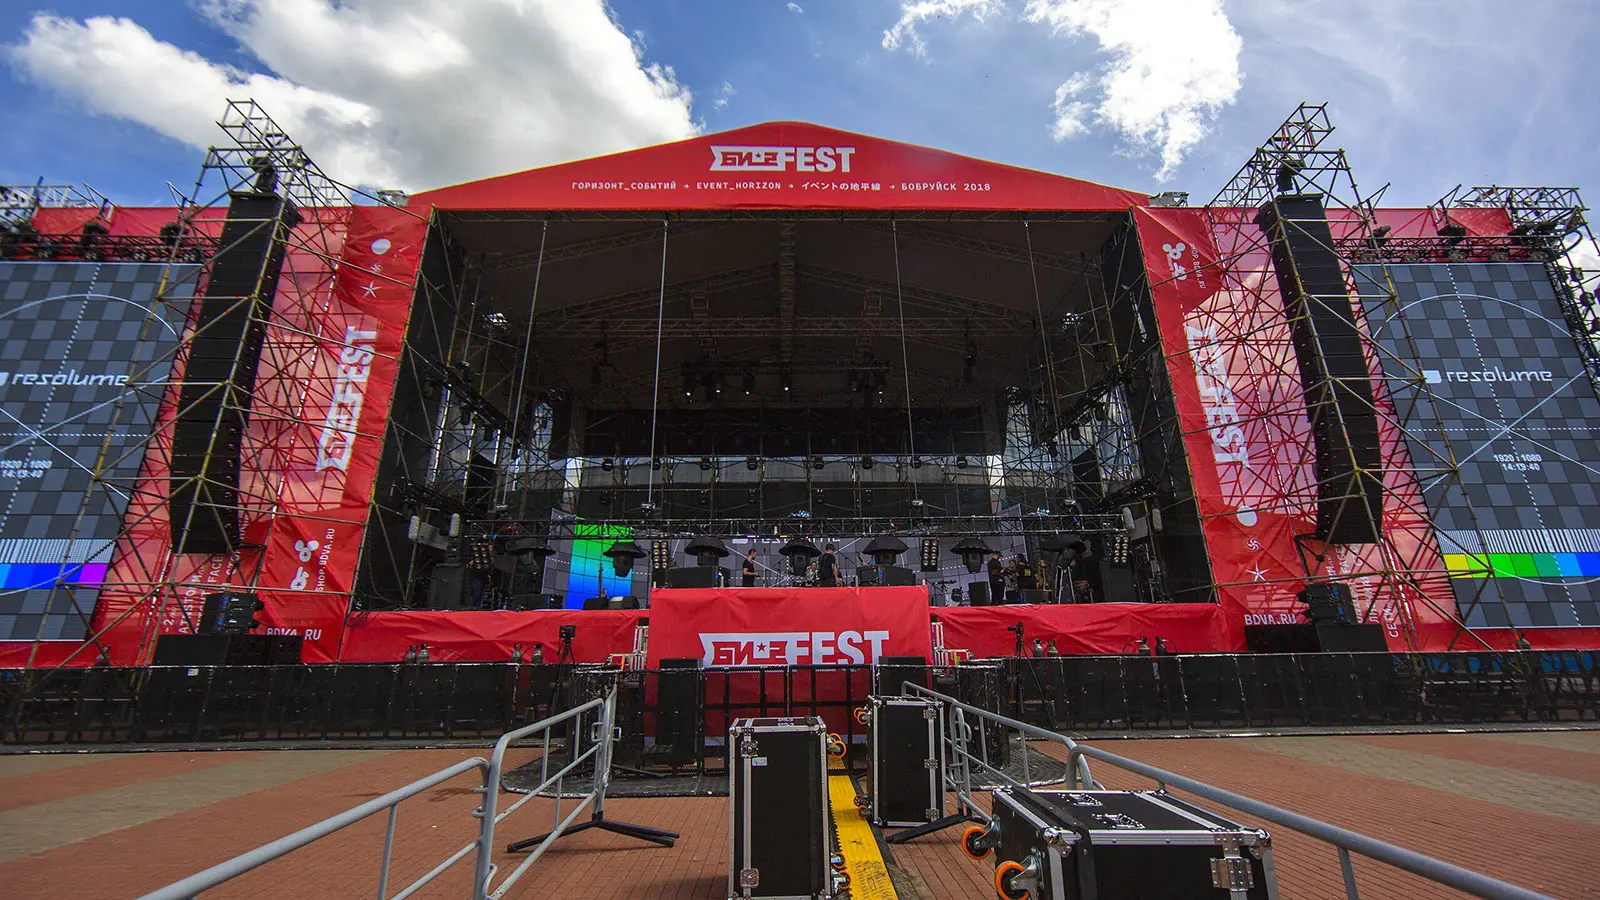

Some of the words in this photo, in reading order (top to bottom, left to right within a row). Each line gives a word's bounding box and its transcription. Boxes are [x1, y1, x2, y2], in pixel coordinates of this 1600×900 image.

[571, 181, 677, 190] ГОРИЗОНТ_СОБЫТИЙ
[696, 182, 782, 190] EVENT_HORIZON
[901, 181, 957, 191] БОБРУЙСК
[963, 183, 991, 191] 2018
[12, 369, 130, 386] resolume
[1445, 366, 1553, 382] resolume
